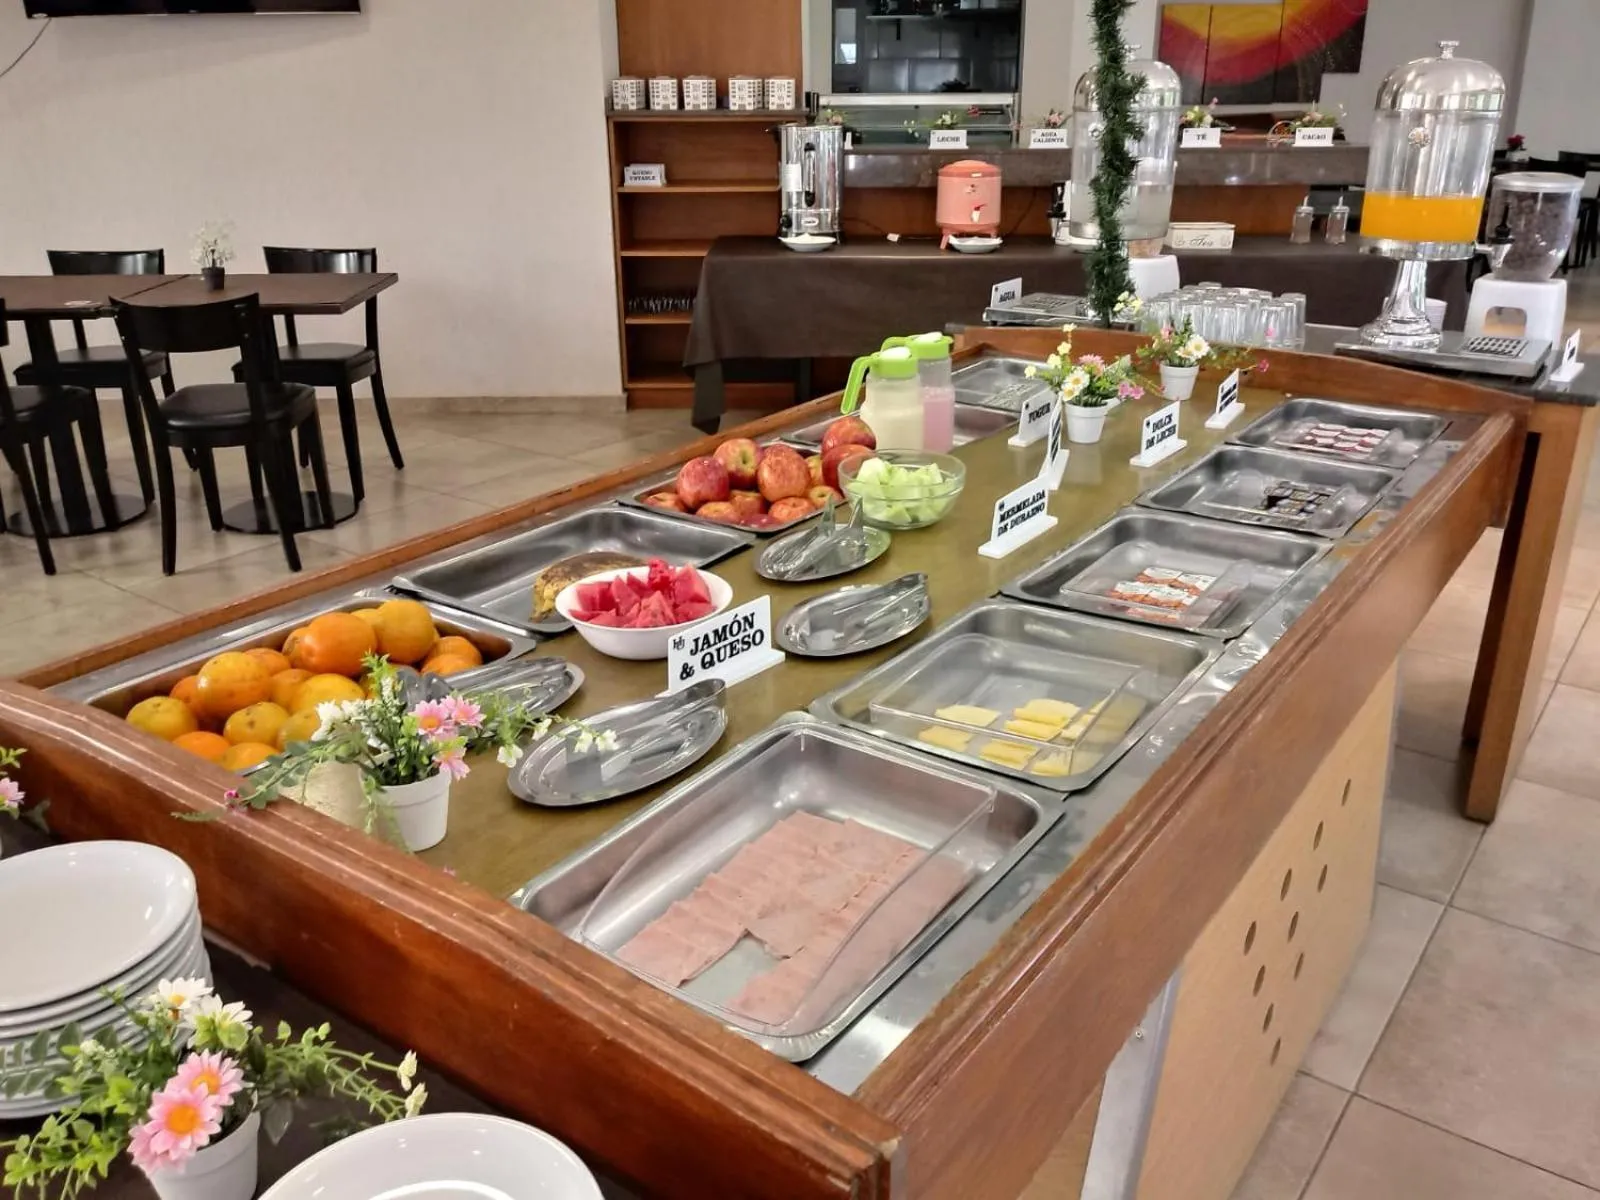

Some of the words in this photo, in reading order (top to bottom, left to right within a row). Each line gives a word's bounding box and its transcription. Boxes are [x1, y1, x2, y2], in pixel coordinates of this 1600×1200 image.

[1145, 435, 1155, 450] DE
[1156, 424, 1177, 444] LECHE
[1152, 413, 1173, 433] DULCE
[997, 522, 1009, 537] DE
[1009, 502, 1045, 529] DURAZNO
[999, 489, 1046, 524] MERMELADA
[690, 612, 755, 656] JAMÓN
[680, 662, 695, 681] &
[700, 629, 765, 670] QUESO
